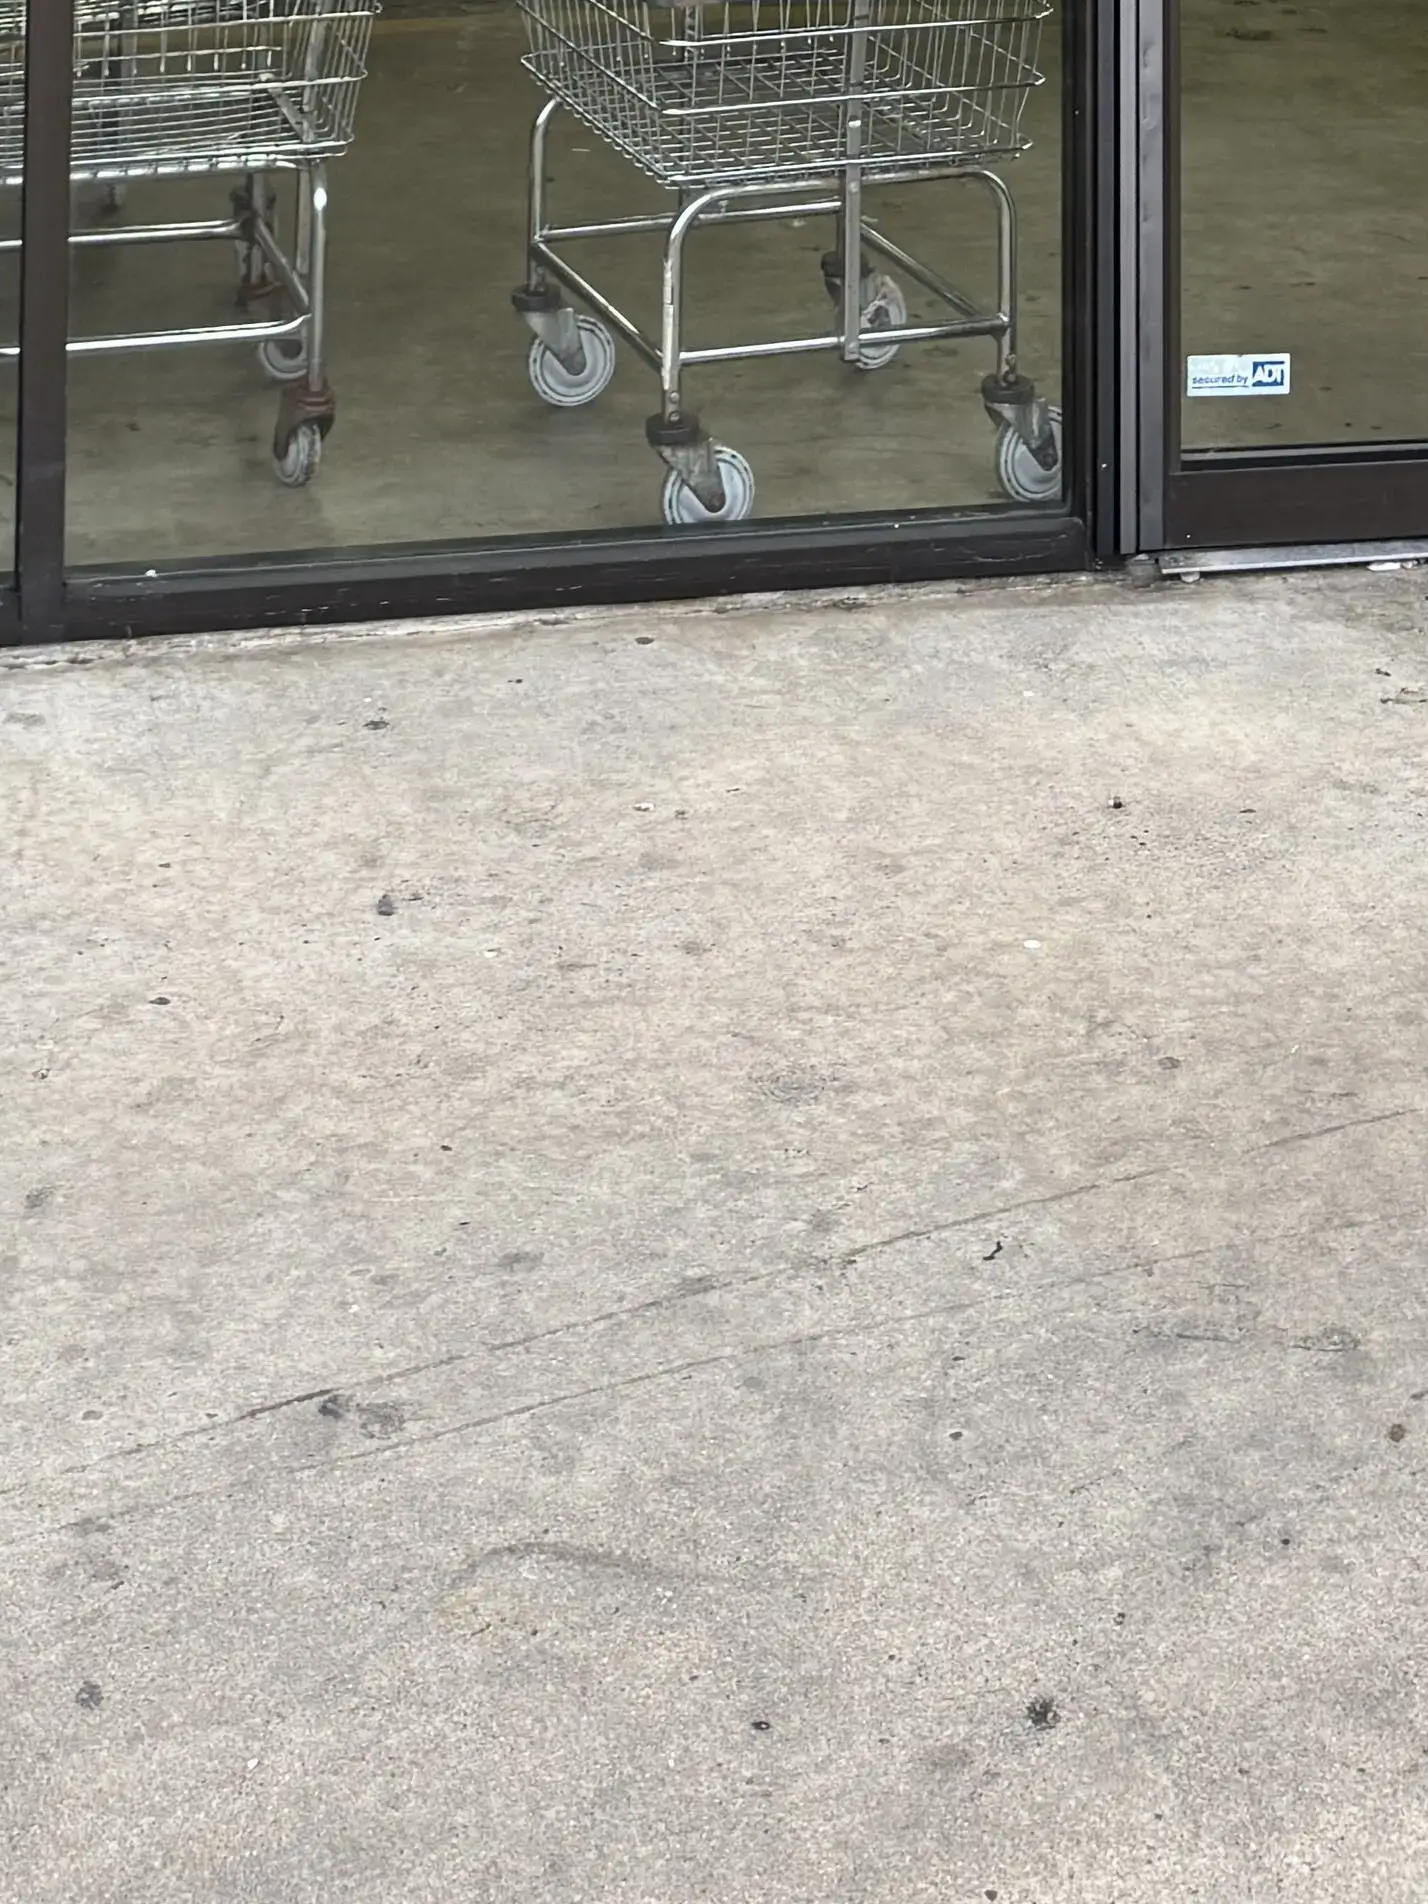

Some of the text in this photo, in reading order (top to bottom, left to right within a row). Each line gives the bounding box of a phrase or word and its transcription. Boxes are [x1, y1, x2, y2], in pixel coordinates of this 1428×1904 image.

[1192, 363, 1285, 385] secured by ADT
